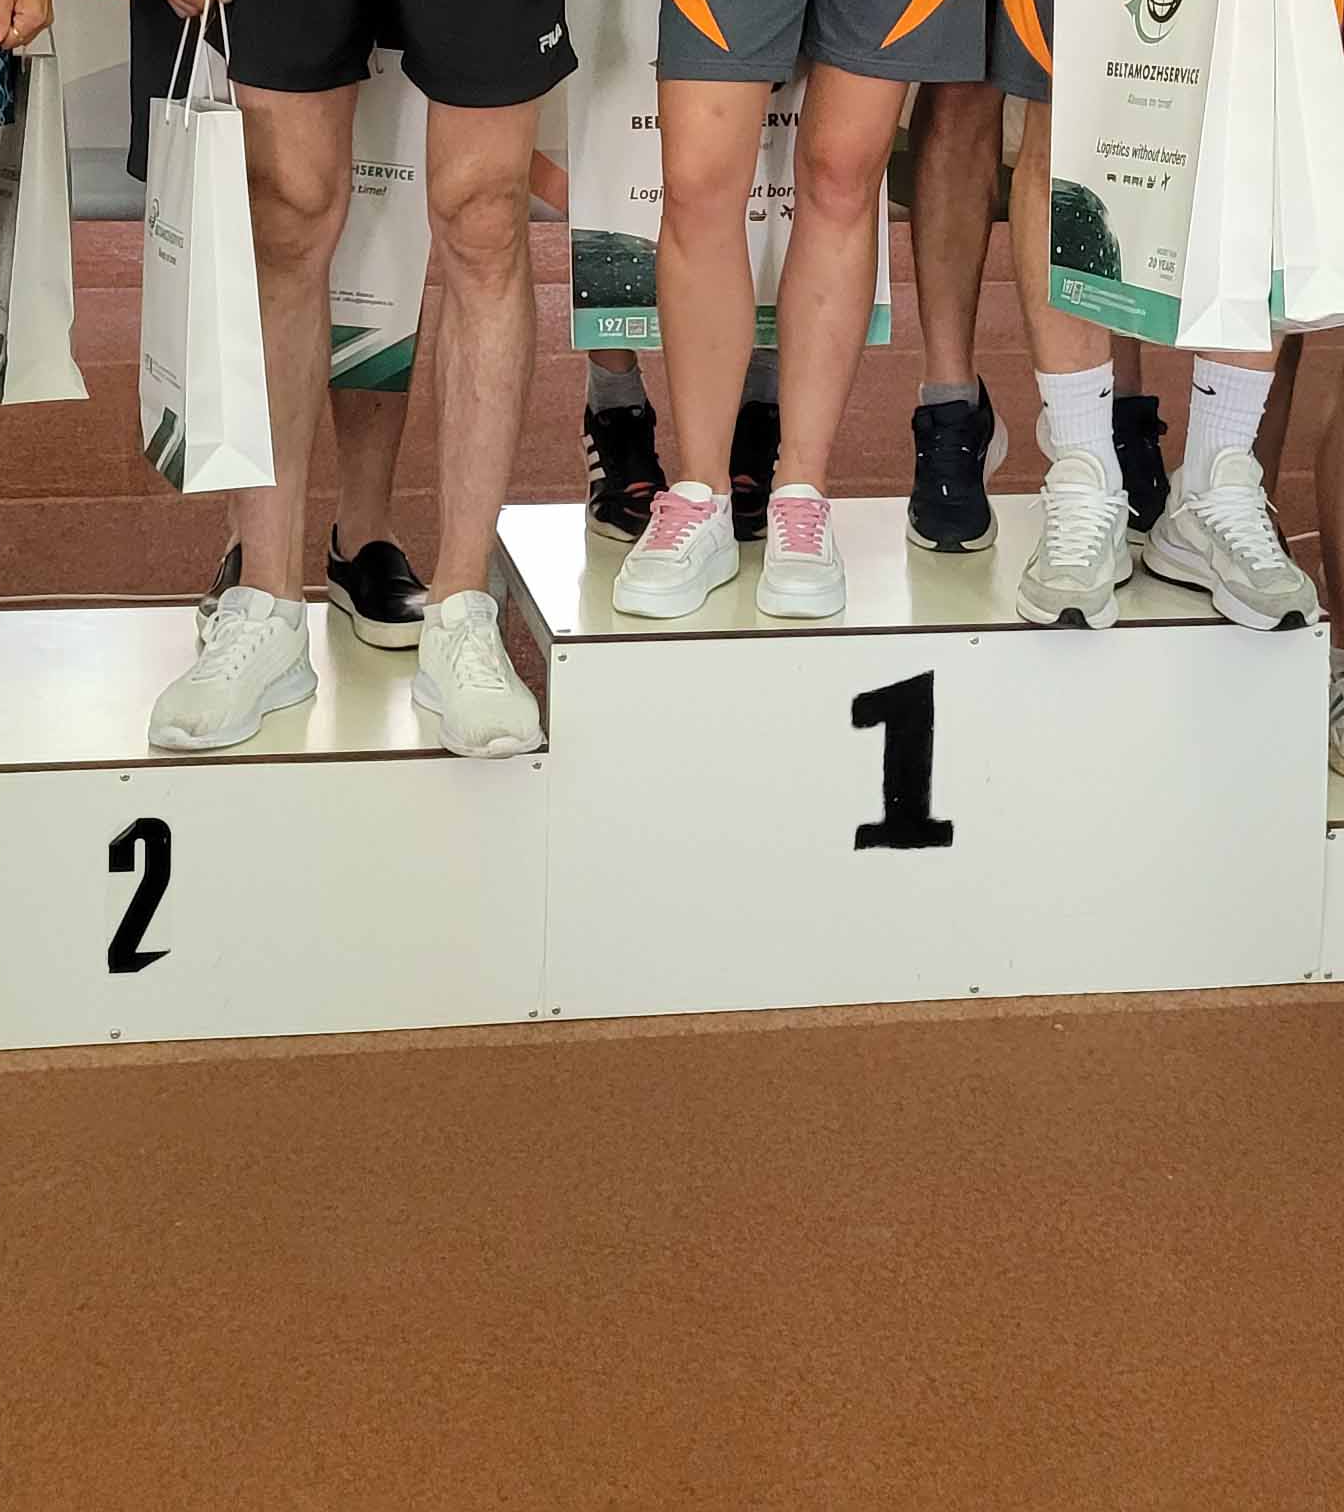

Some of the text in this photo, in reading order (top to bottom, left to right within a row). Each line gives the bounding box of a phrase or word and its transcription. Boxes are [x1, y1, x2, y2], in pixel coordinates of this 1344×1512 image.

[539, 23, 562, 53] FILA
[1106, 61, 1200, 85] BELTAMOZHSERVICE
[1096, 136, 1187, 167] Logistics without borders
[358, 186, 387, 196] time!
[598, 317, 623, 331] 197
[851, 669, 954, 850] 1
[107, 817, 172, 974] 2
